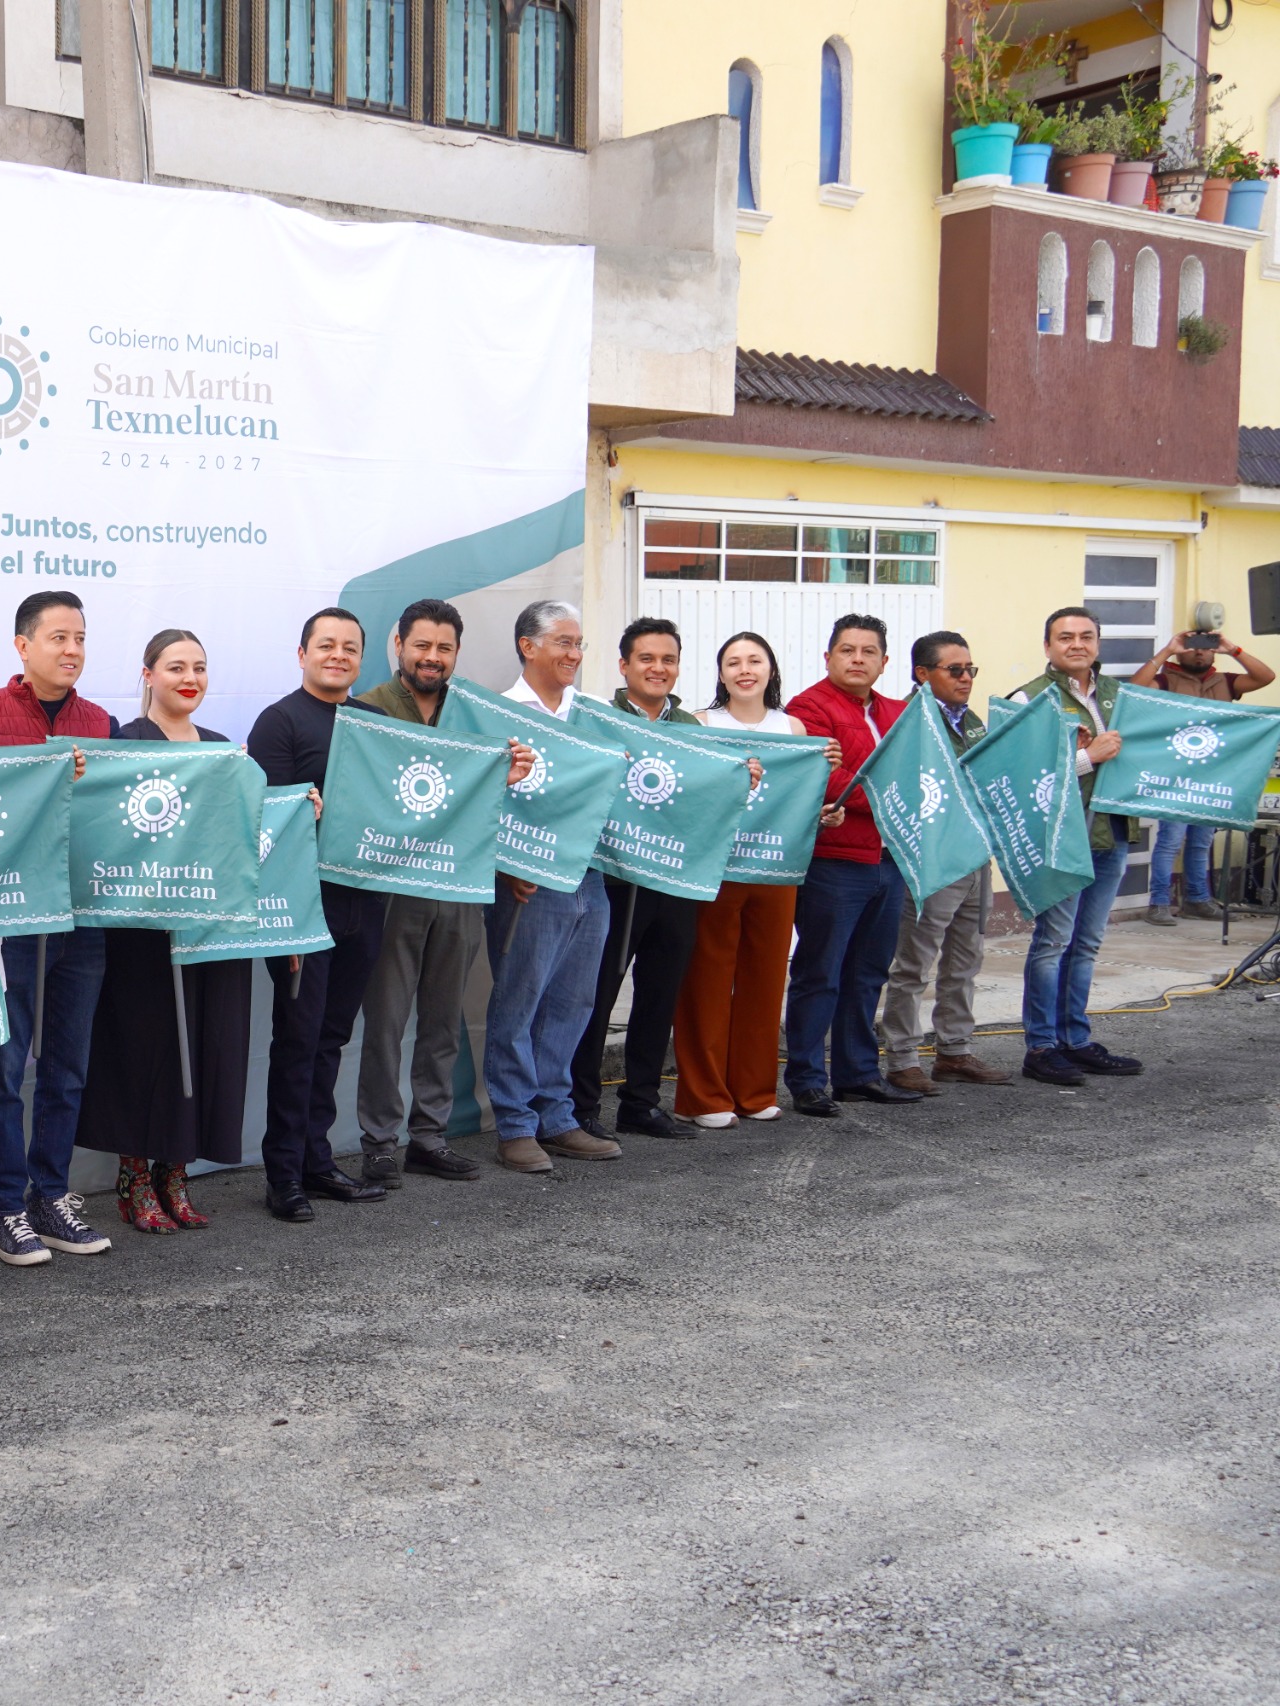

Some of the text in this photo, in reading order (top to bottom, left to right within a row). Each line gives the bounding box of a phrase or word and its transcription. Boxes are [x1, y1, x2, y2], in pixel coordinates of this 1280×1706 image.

[89, 325, 279, 360] Gobierno Municipal
[93, 363, 274, 405] San Martín
[86, 398, 279, 441] Texmelucan
[0, 513, 268, 549] Juntos, construyendo
[0, 550, 117, 578] el futuro
[887, 781, 907, 814] San
[1134, 782, 1233, 810] Texmelucan
[1138, 770, 1233, 797] San Martín
[623, 821, 686, 853] Martín
[986, 779, 1034, 877] Texmelucan
[997, 775, 1045, 868] San Martín
[361, 826, 455, 857] San Martín
[93, 860, 215, 880] San Martín
[355, 842, 456, 874] Texmelucan
[88, 879, 217, 900] Texmelucan
[257, 893, 289, 910] rtín
